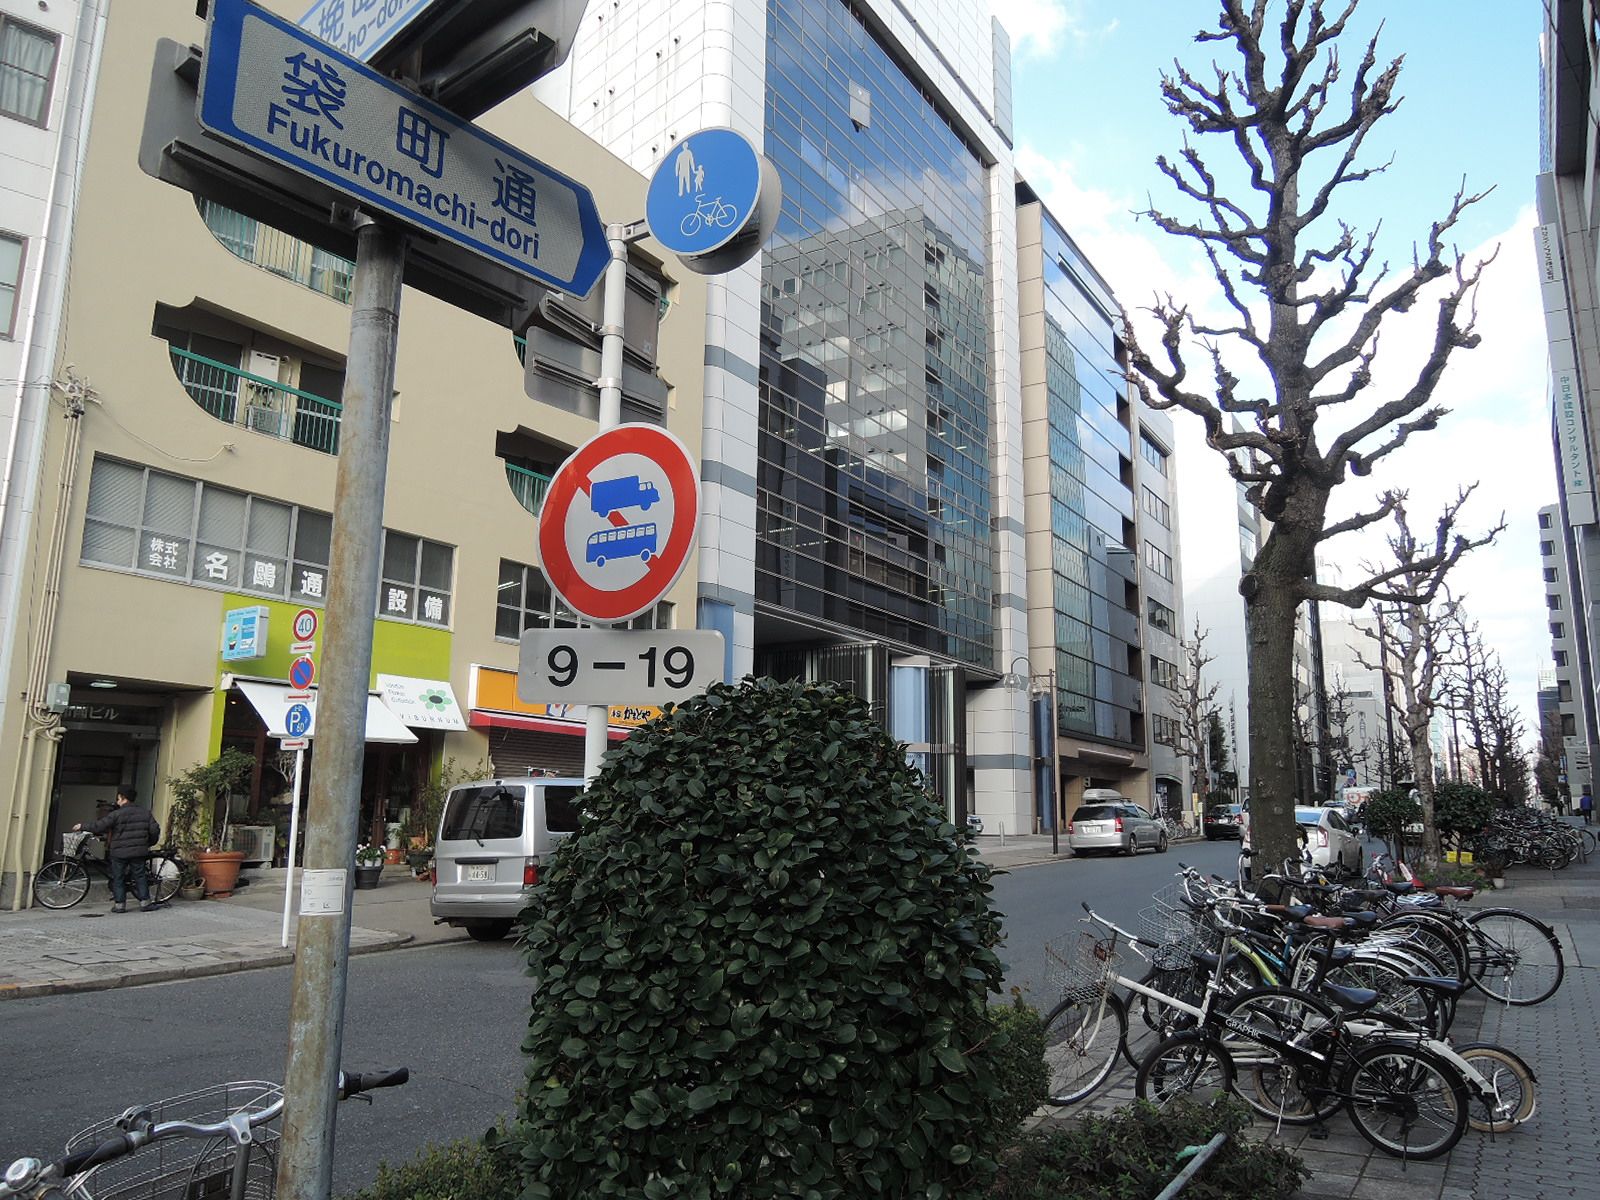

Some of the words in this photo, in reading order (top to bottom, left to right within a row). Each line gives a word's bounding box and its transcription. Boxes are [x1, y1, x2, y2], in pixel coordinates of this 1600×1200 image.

[266, 102, 541, 261] Fukuromachi-dori
[280, 51, 538, 228] 袋町通
[298, 618, 312, 633] 40
[290, 711, 301, 733] P
